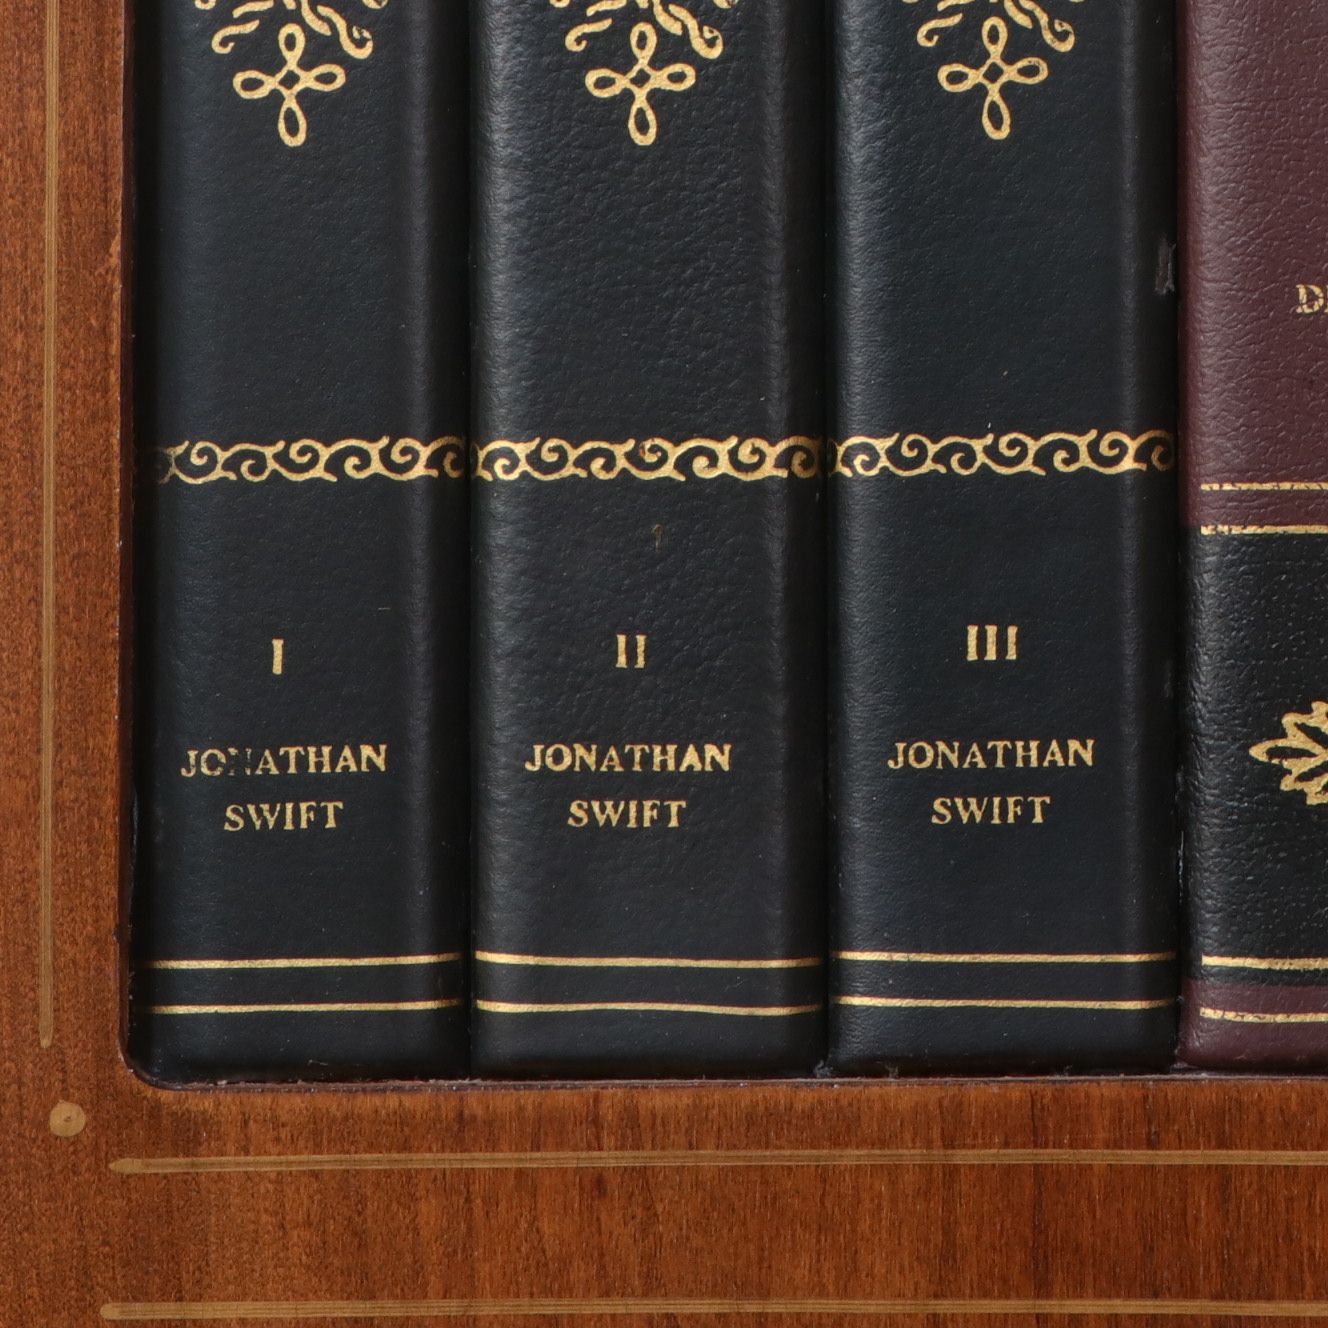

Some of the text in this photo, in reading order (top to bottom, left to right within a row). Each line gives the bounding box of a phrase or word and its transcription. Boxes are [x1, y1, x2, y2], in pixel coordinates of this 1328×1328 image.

[271, 638, 284, 675] I
[615, 634, 647, 669] II
[966, 624, 1018, 661] III
[524, 743, 731, 772] JONATHAN
[887, 739, 1095, 769] JONATHAN
[224, 801, 343, 832] SWIFT
[567, 799, 686, 828] SWIFT
[931, 796, 1050, 824] SWIFT
